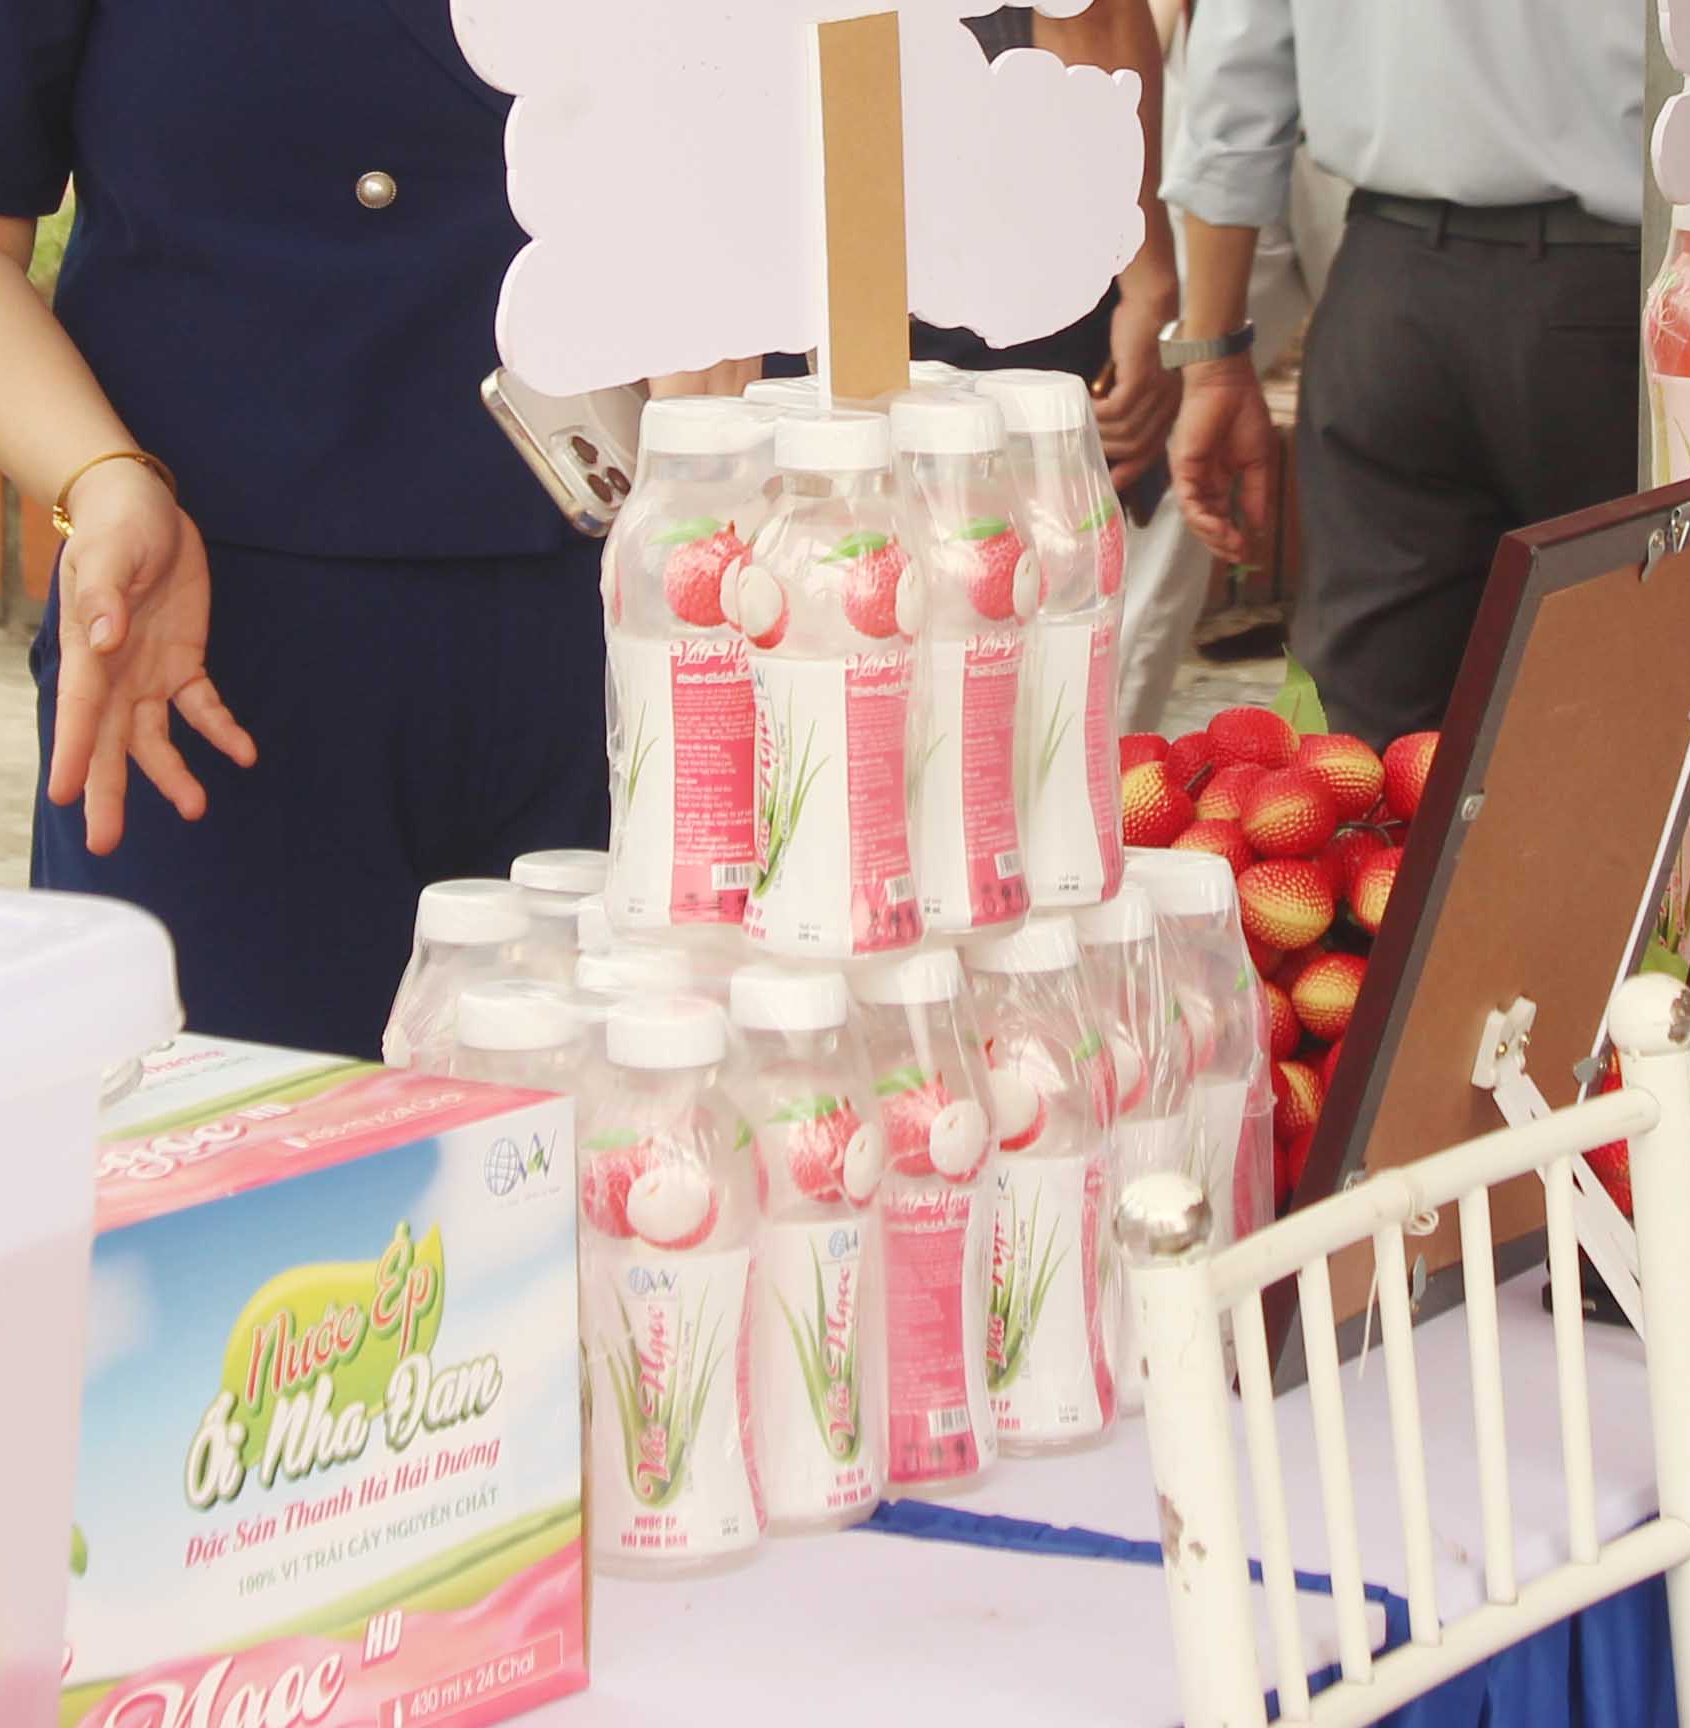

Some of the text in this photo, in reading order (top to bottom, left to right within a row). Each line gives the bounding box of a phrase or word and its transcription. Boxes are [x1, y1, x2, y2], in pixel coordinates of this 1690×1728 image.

[245, 1302, 366, 1410] Nước
[261, 1371, 369, 1489] Nha
[384, 1352, 502, 1453] Đam
[285, 1483, 354, 1533] Thanh
[434, 1436, 502, 1481] Dương
[386, 1501, 451, 1541] NGUYÊN
[365, 1610, 404, 1666] HD
[410, 1687, 441, 1719] 430
[440, 1679, 462, 1709] ml
[462, 1679, 476, 1700] x
[475, 1667, 496, 1695] 24
